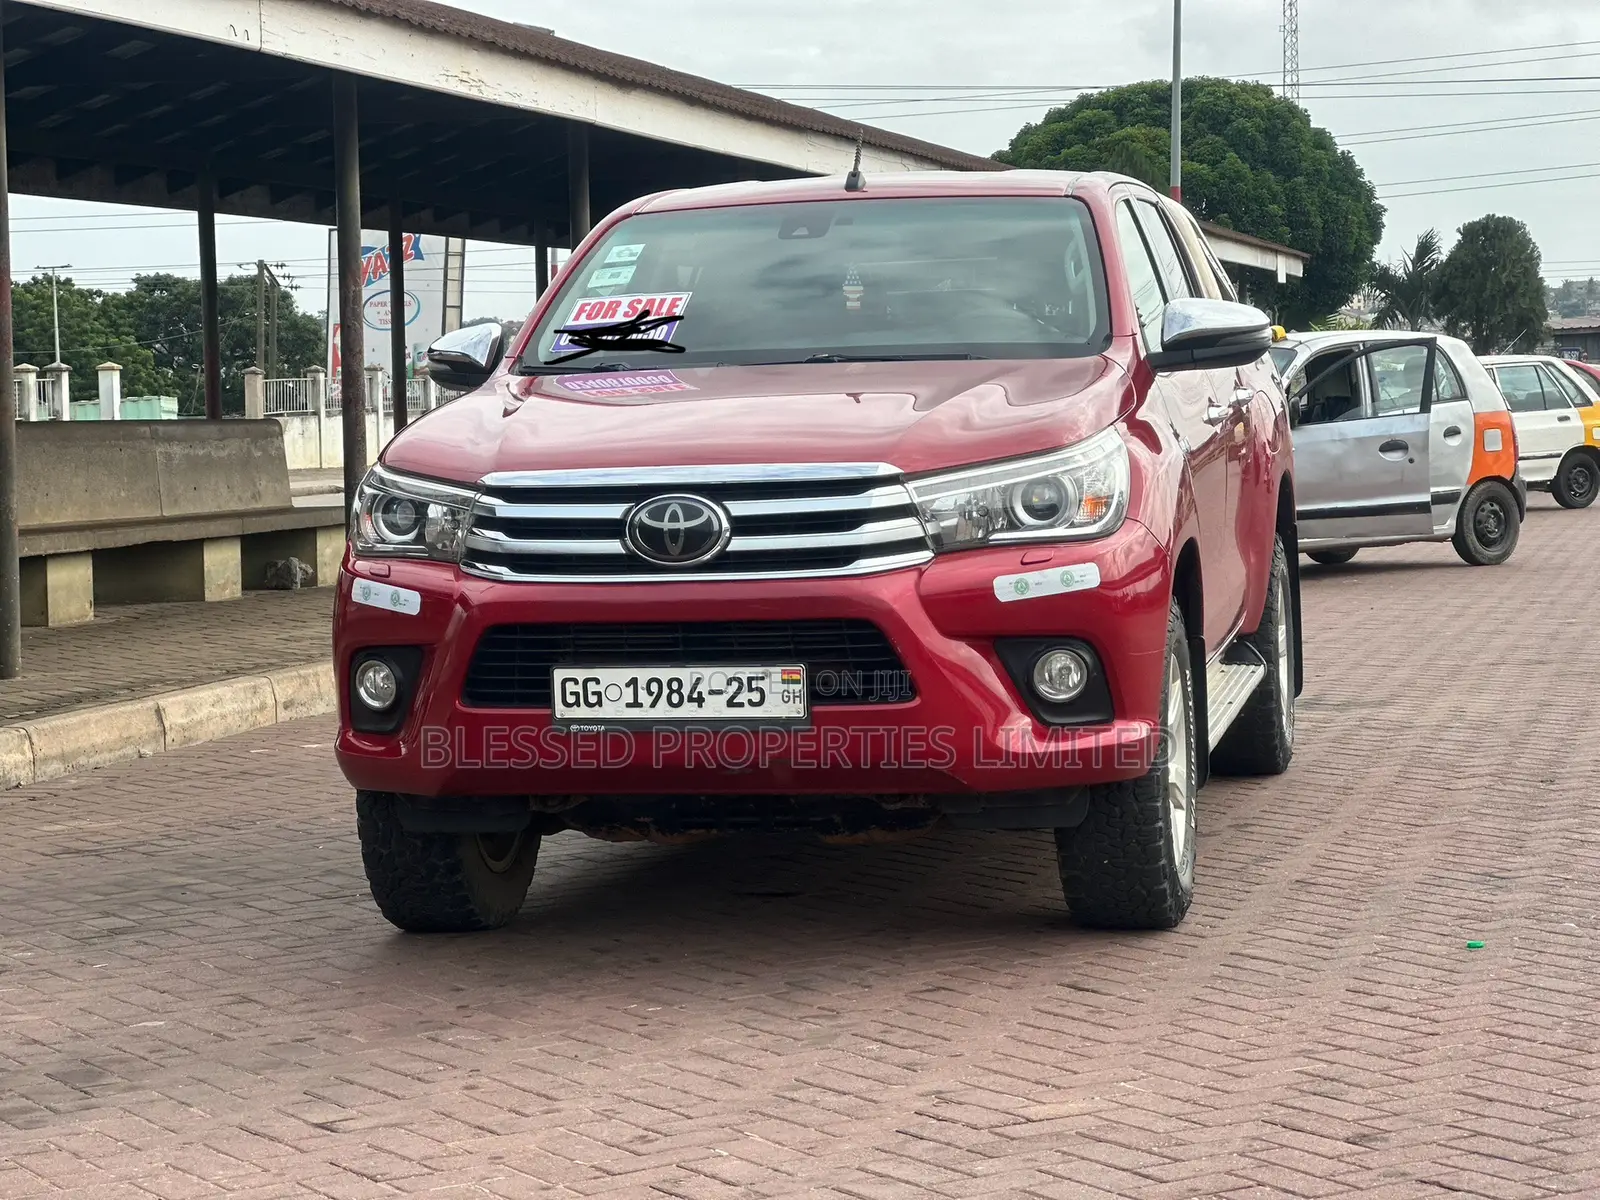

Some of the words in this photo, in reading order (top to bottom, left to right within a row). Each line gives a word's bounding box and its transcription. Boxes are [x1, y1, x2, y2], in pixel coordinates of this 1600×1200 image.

[572, 300, 622, 321] FOR
[623, 297, 683, 318] SALE
[560, 677, 603, 708] GG
[625, 675, 767, 708] 1984-25
[781, 689, 802, 705] GH
